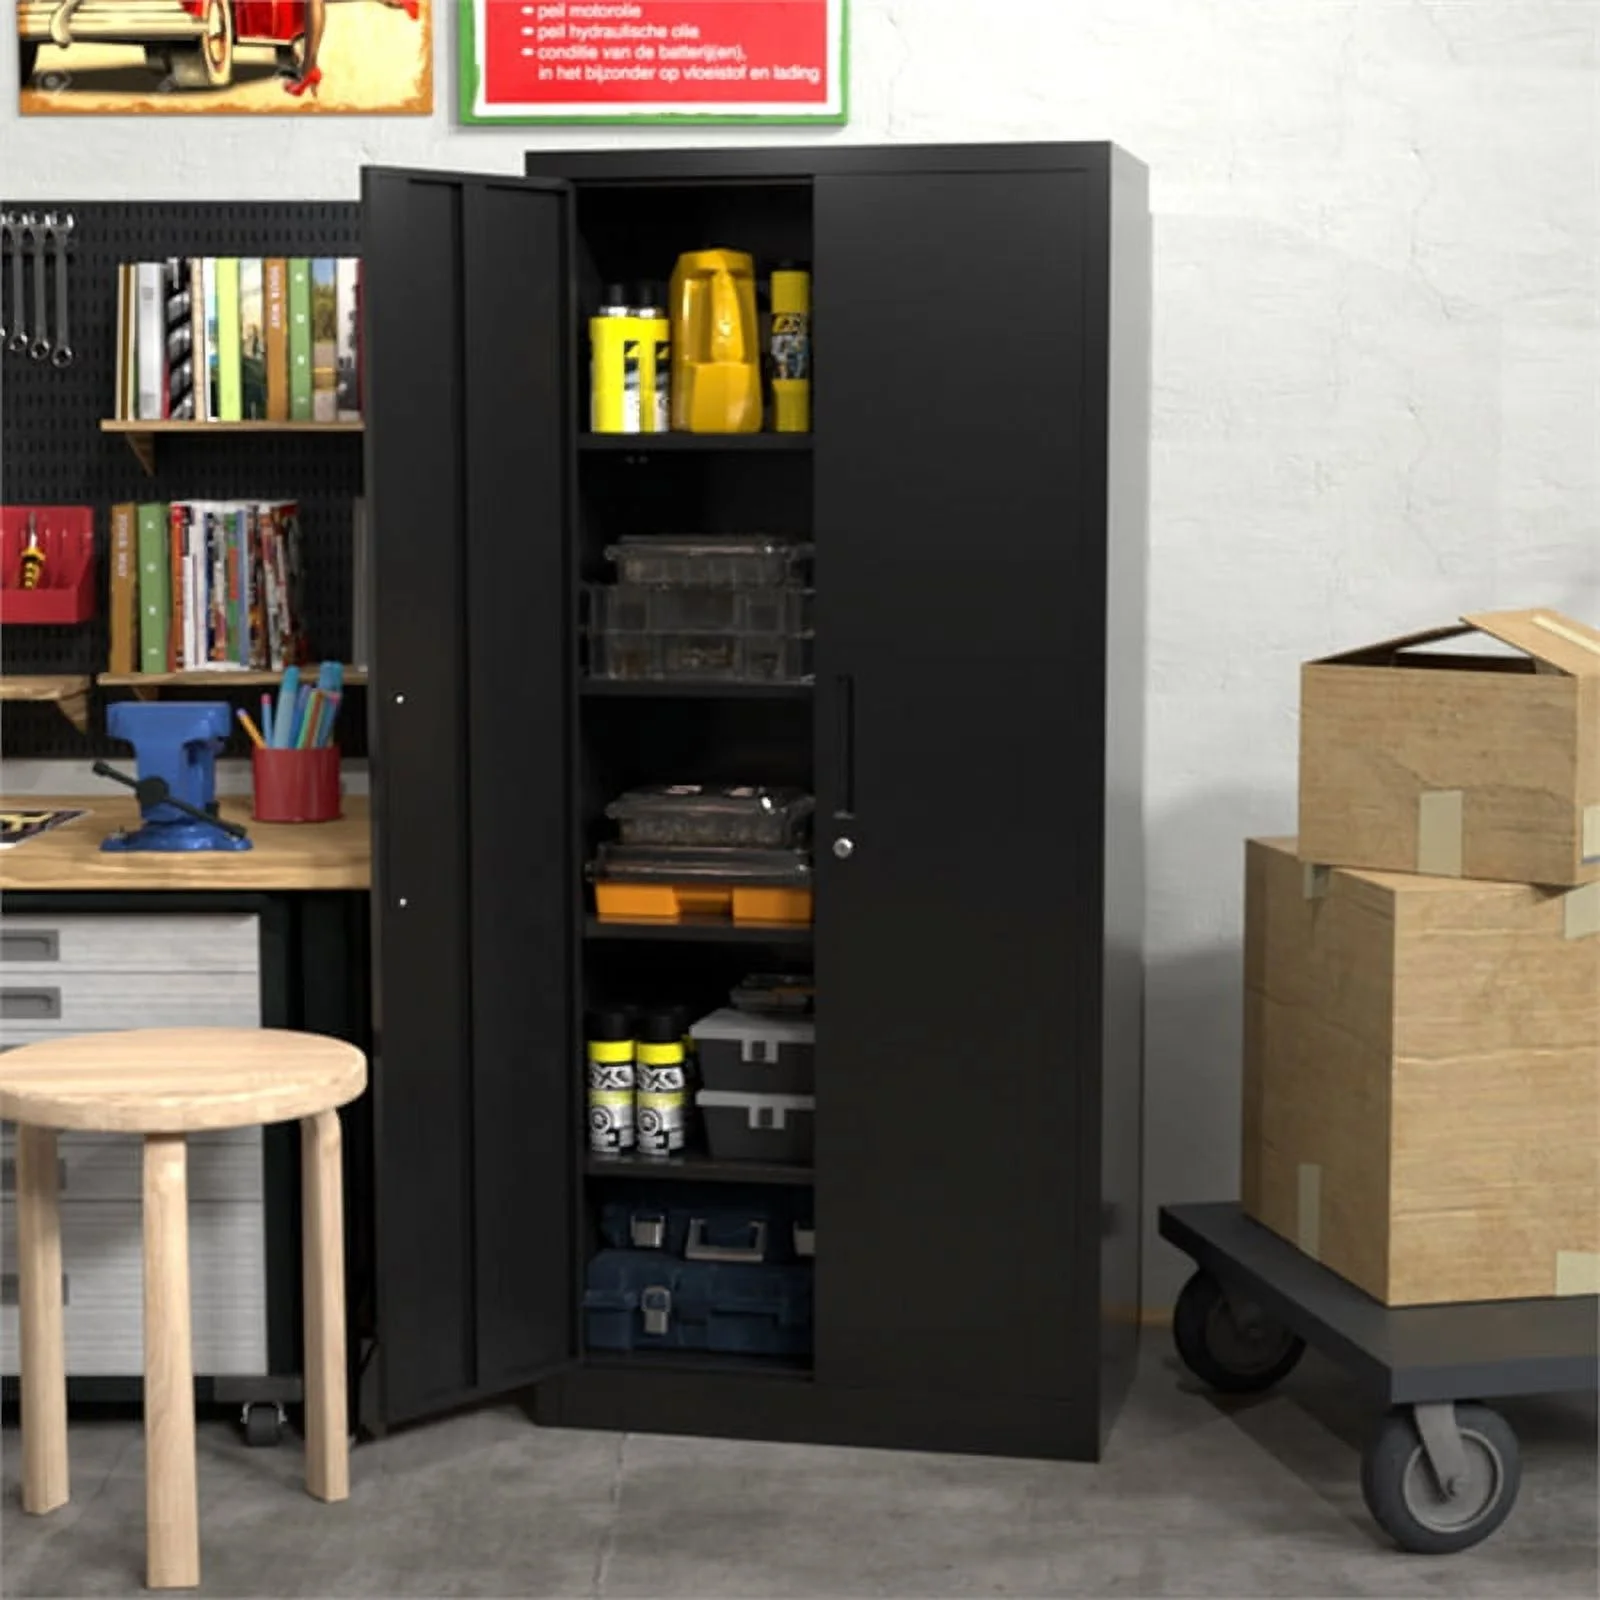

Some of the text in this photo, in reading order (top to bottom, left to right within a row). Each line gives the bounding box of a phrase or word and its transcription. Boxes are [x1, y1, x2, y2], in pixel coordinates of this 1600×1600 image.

[537, 3, 643, 21] peil motorolie
[537, 23, 699, 41] peil hydraulische olie
[537, 44, 599, 60] conditie
[602, 47, 632, 60] van
[634, 44, 655, 60] de
[538, 64, 820, 84] in het bijzonder op vloeistof en lading
